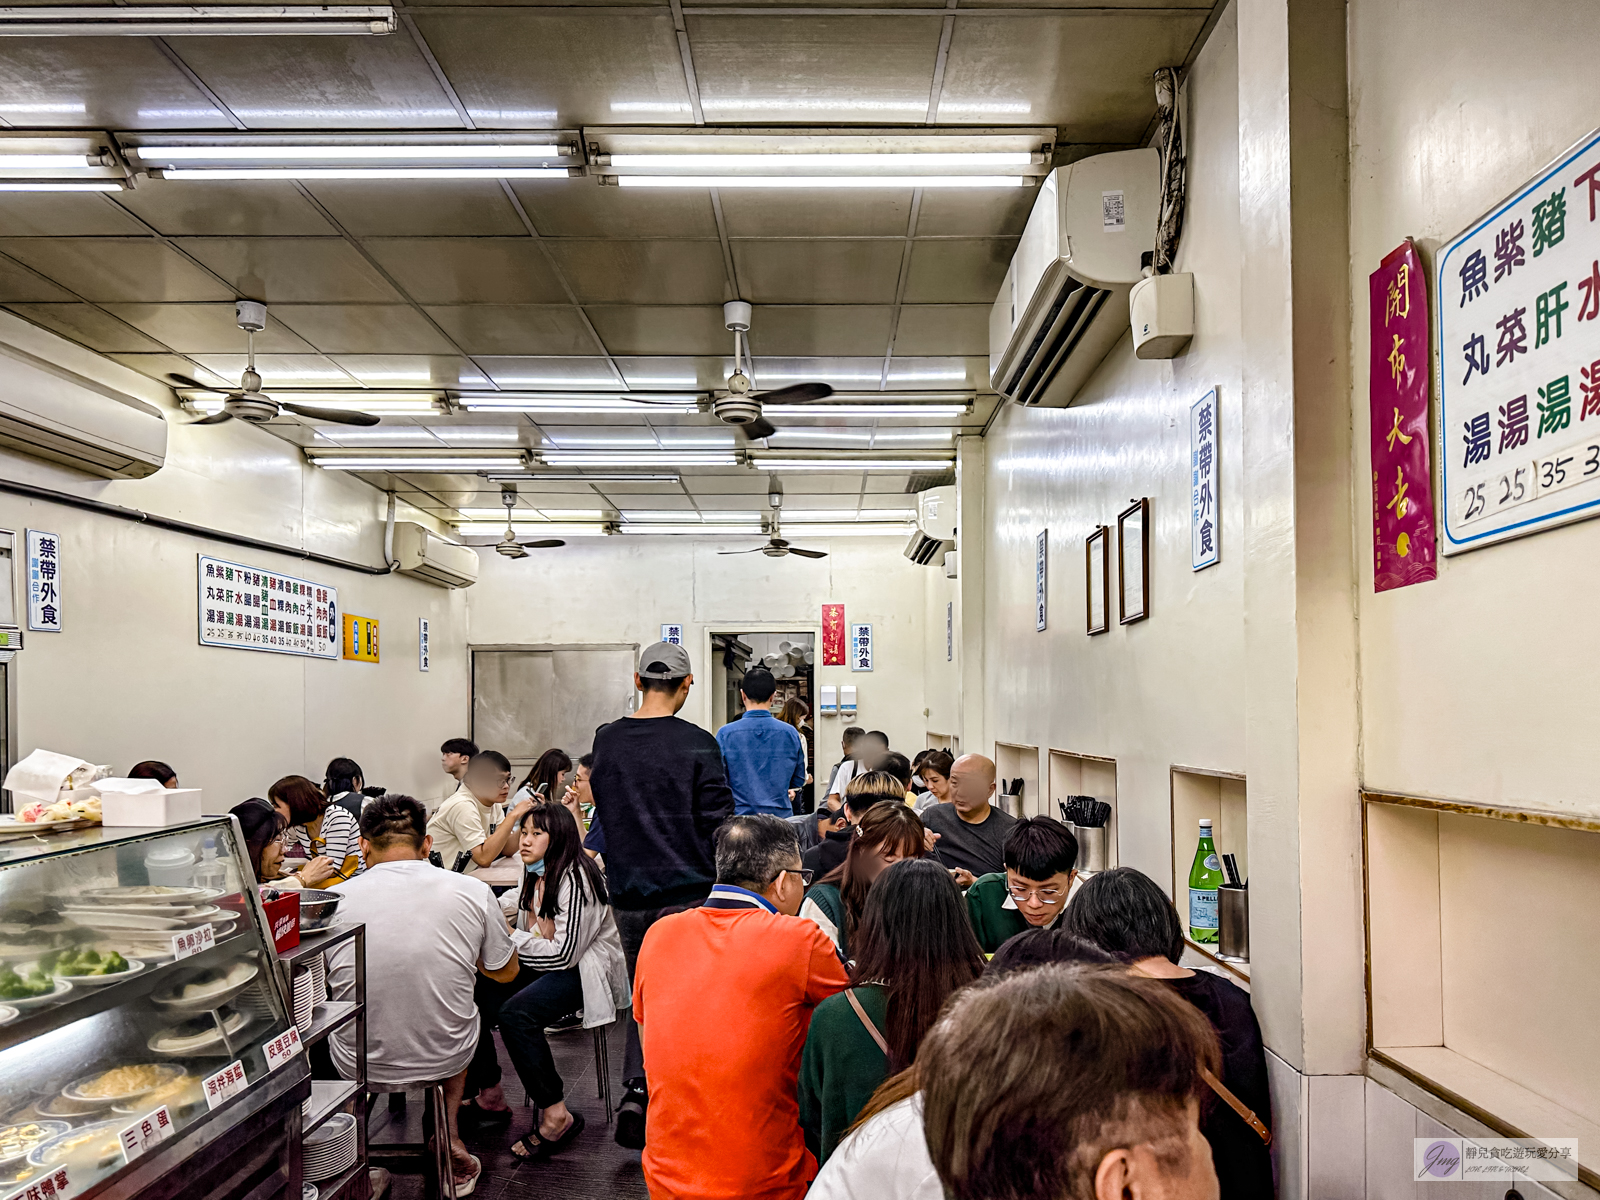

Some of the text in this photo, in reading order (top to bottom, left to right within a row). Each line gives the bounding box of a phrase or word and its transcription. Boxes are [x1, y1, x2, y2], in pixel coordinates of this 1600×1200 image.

[1532, 186, 1571, 439] 豬肝湯
[1494, 218, 1530, 455] 紫菜湯
[1459, 248, 1491, 468] 魚丸湯
[1385, 263, 1412, 520] 開市大吉
[1541, 456, 1574, 488] 35
[1583, 445, 1600, 475] 3
[1199, 403, 1213, 556] 禁帶外食
[1499, 468, 1526, 505] 25
[1464, 483, 1486, 520] 25
[39, 537, 57, 625] 禁帶外食
[206, 563, 215, 623] 魚丸湯
[216, 565, 225, 624] 紫菜湯
[225, 566, 234, 626] 豬肝湯
[235, 569, 243, 627] 下水湯
[261, 634, 269, 644] 35
[269, 635, 277, 645] 40
[277, 636, 285, 646] 35
[300, 639, 306, 648] 50
[318, 641, 327, 652] 50
[858, 626, 870, 668] 禁帶外食
[177, 927, 213, 953] 魚卵沙拉
[267, 1029, 299, 1059] 皮蛋豆腐
[281, 1049, 292, 1060] 50
[125, 1109, 170, 1149] 三色蛋
[13, 1170, 70, 1200] 味鴨掌
